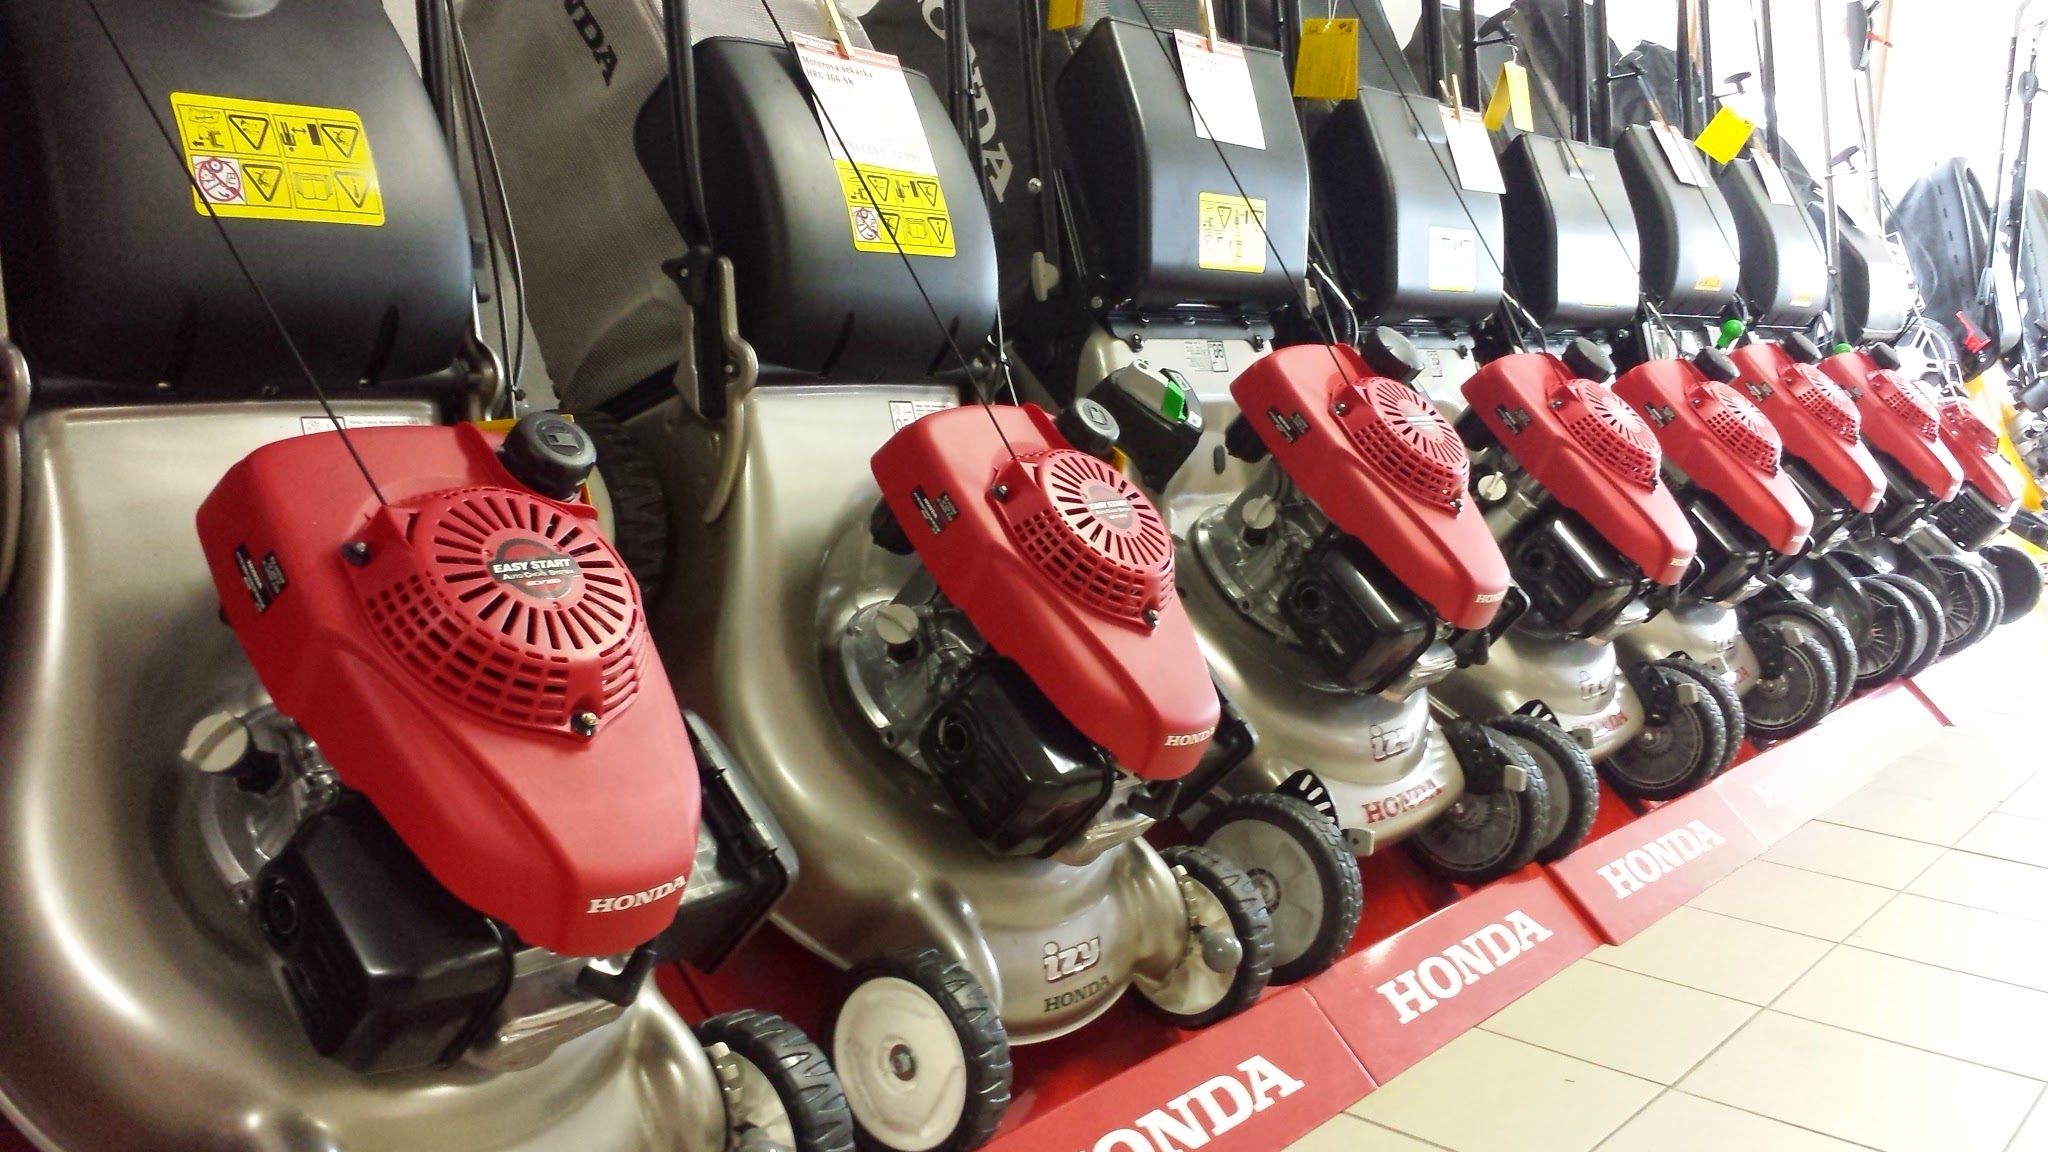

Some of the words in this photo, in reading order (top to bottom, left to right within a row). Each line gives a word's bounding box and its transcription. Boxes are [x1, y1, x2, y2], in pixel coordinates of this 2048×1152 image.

[492, 561, 528, 574] EASY
[530, 558, 571, 569] START
[1362, 778, 1443, 823] HONDA
[1596, 819, 1727, 899] HONDA
[587, 875, 686, 913] HONDA
[1042, 936, 1100, 983] izy
[1375, 909, 1554, 1025] HONDA
[1043, 975, 1110, 1013] HONDA
